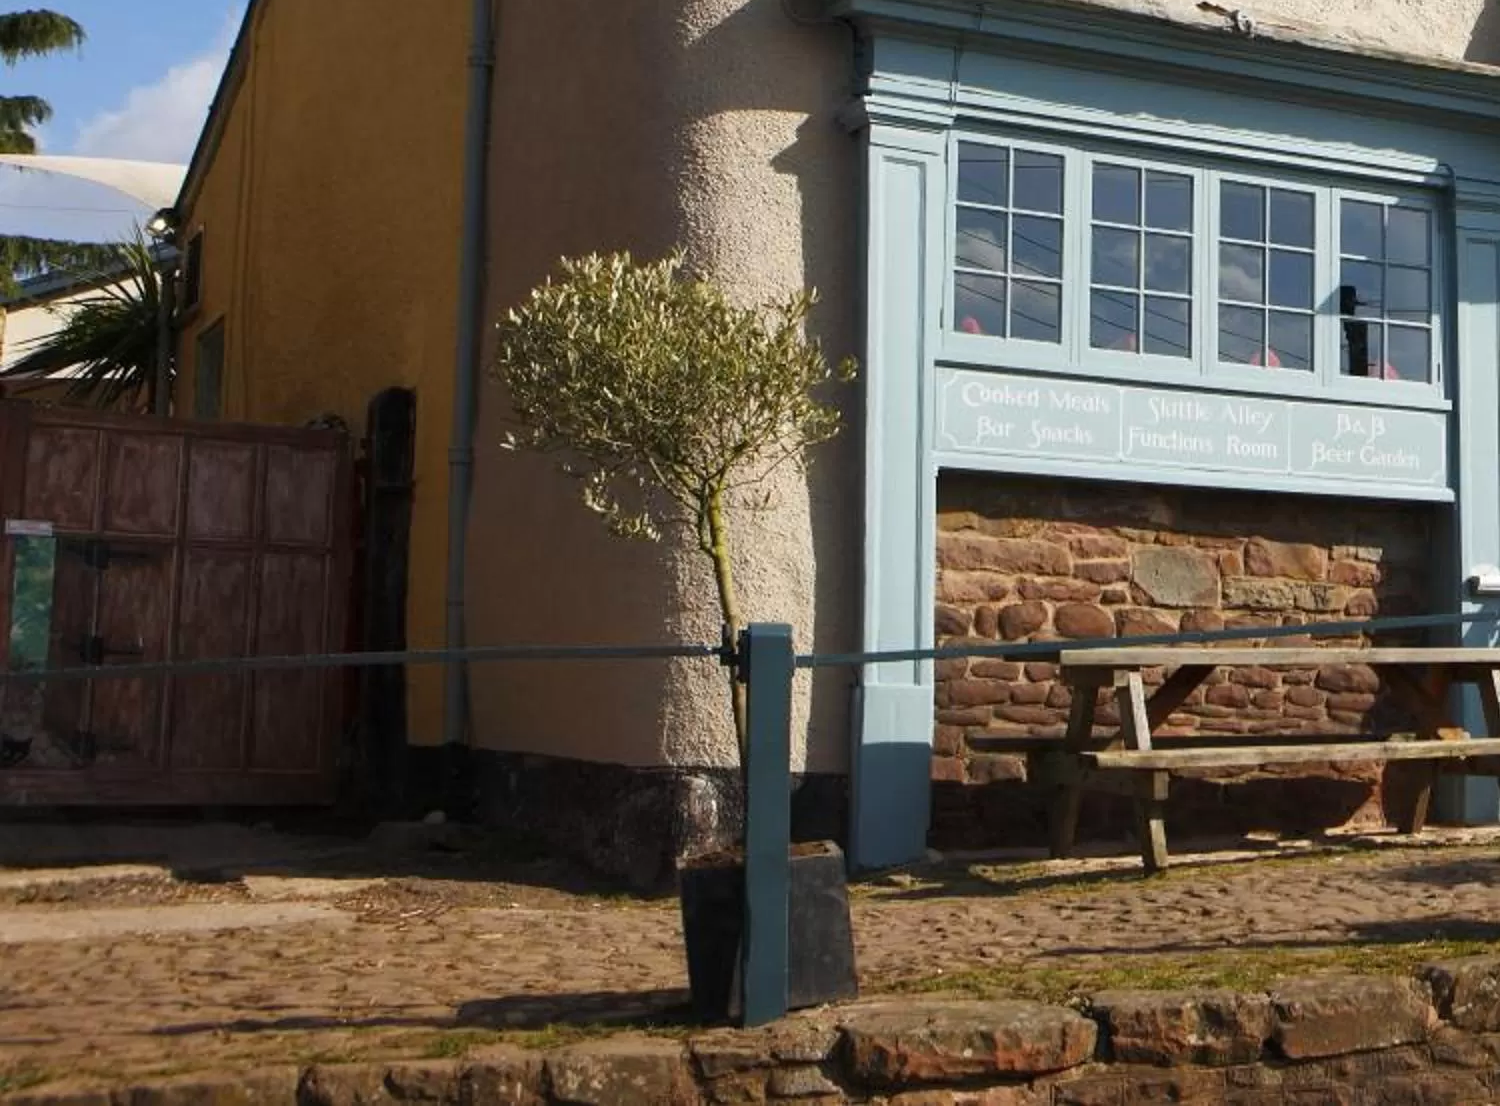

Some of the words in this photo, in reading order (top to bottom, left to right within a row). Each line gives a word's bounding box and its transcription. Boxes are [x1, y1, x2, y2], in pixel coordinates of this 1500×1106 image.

[962, 381, 1039, 408] Cooked
[1048, 389, 1110, 414] Meals
[977, 415, 1015, 445] Bar
[1027, 419, 1093, 448] Snacks
[1149, 396, 1213, 424] Skittle
[1221, 402, 1273, 434] Alley
[1126, 426, 1213, 455] Functions
[1227, 434, 1278, 459] Room
[1308, 439, 1354, 470] Beer
[1359, 445, 1420, 471] Garden
